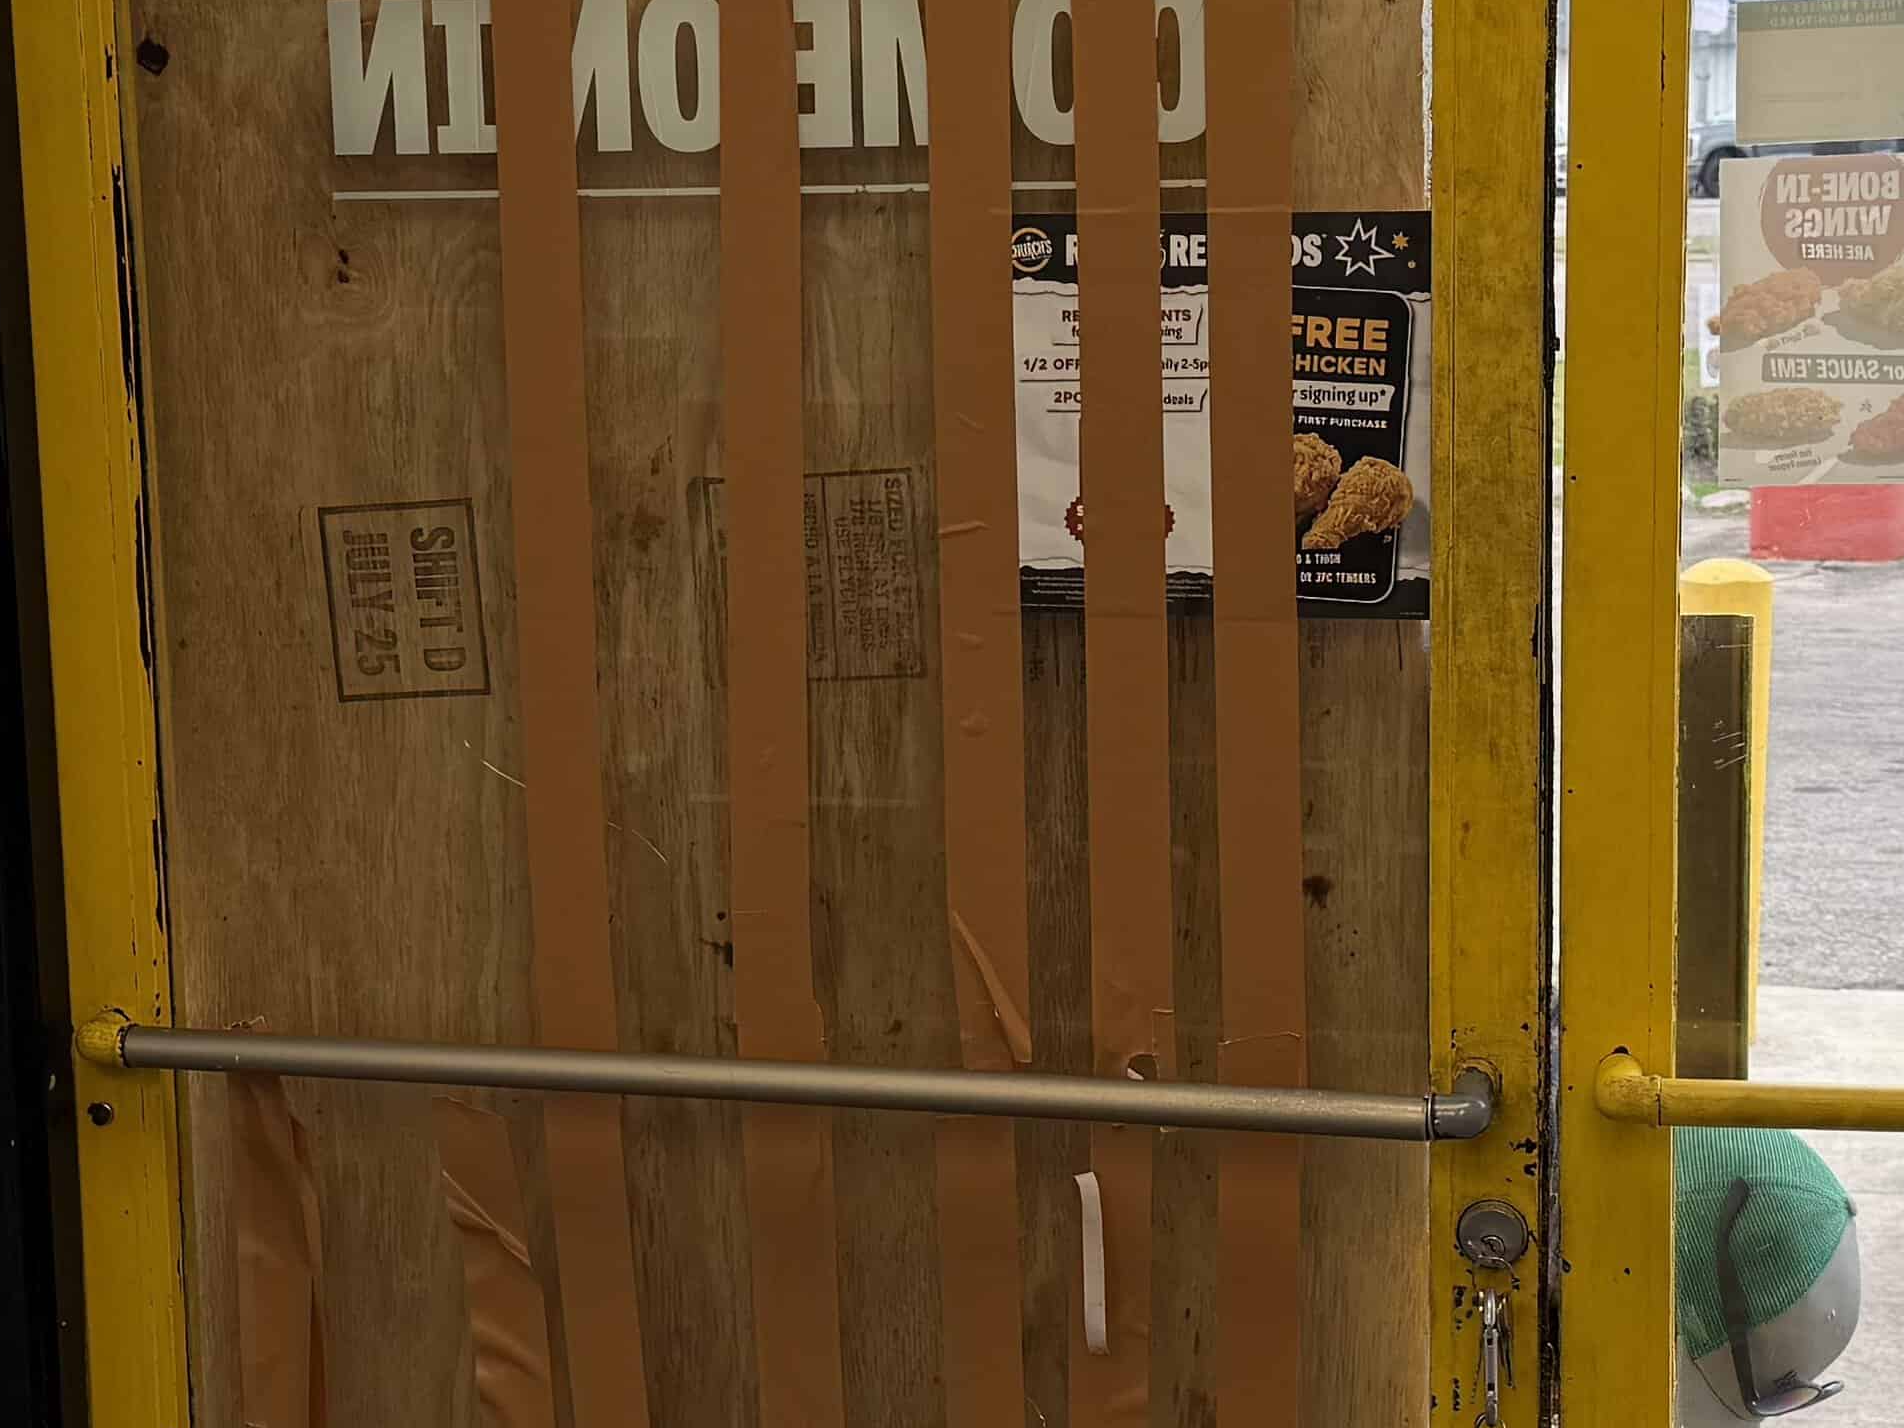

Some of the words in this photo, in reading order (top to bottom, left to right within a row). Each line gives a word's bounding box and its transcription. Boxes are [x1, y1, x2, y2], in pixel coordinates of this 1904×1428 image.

[1293, 317, 1390, 352] FREE
[1294, 356, 1386, 376] HICKEN
[1299, 387, 1356, 407] signing
[1298, 416, 1326, 427] FIRST
[1329, 417, 1388, 429] PURCHASE
[422, 646, 467, 672] D
